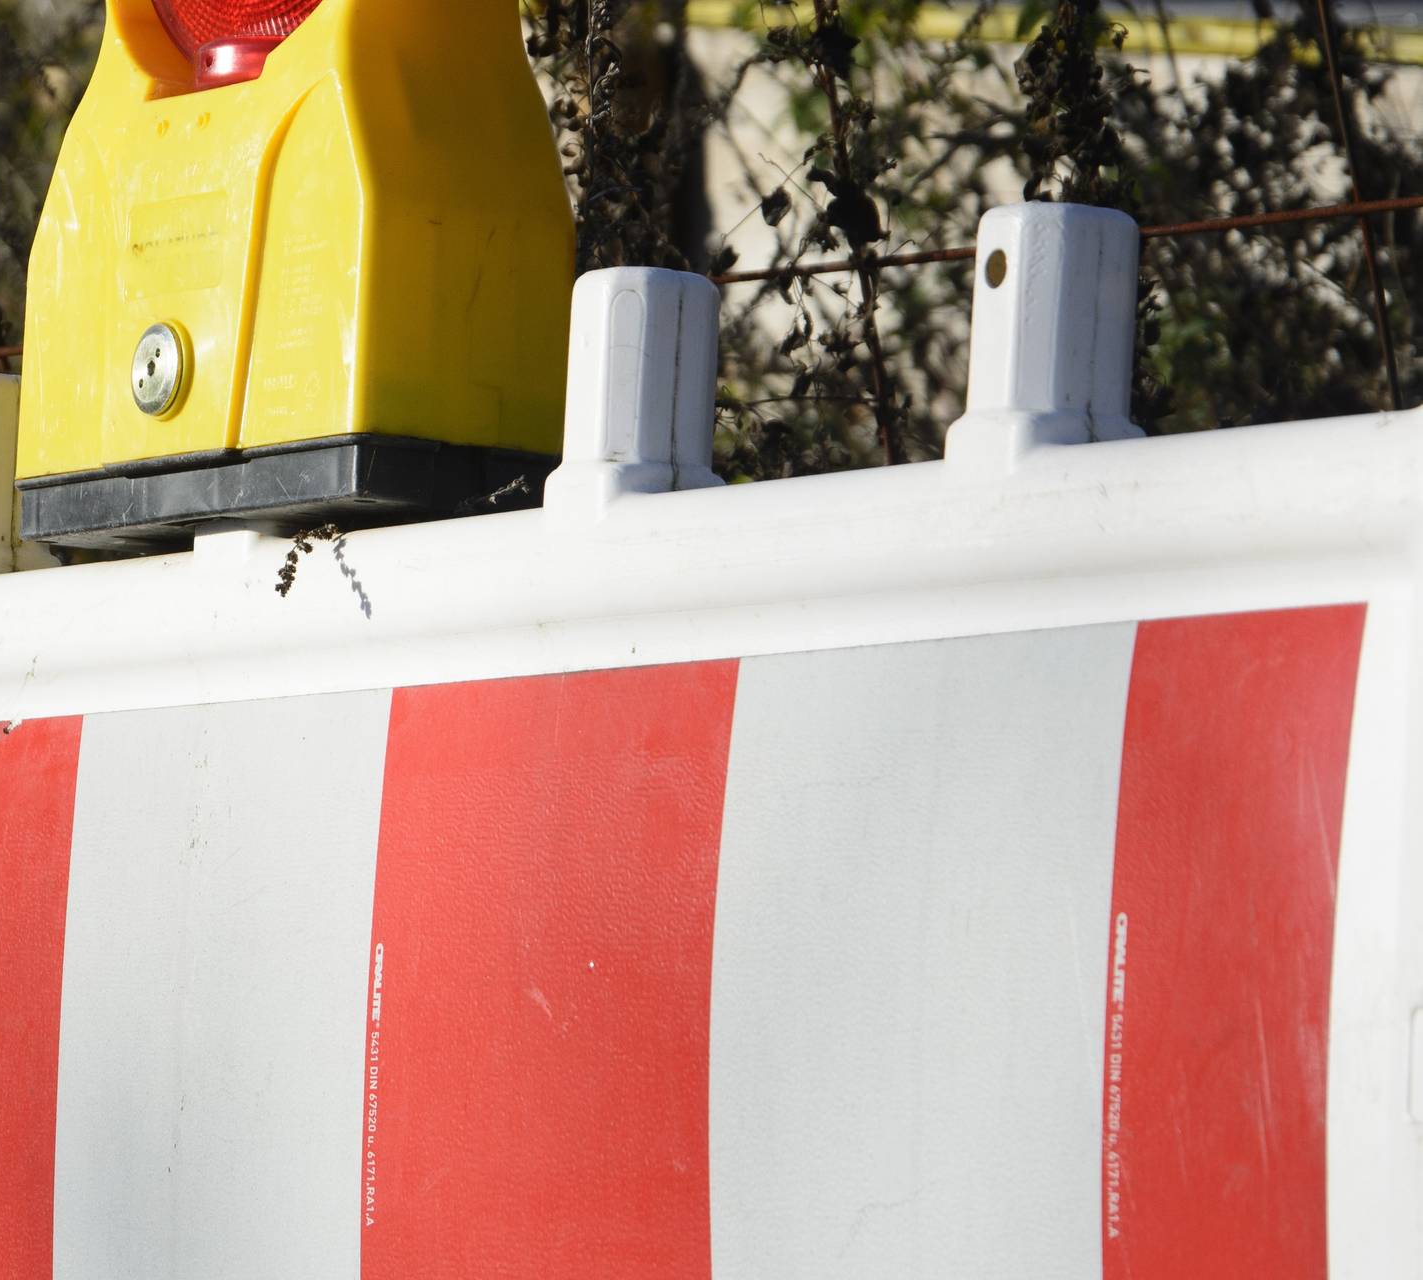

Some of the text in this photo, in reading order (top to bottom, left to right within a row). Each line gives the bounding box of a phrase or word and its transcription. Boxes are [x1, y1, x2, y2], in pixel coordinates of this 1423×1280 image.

[372, 943, 384, 1022] ORALITE
[370, 1031, 379, 1062] 5431
[1110, 1014, 1123, 1049] 5431
[369, 1066, 378, 1090] DIN
[1109, 1053, 1122, 1081] DIN
[368, 1093, 378, 1132] 67520
[1108, 1084, 1121, 1131] 67520
